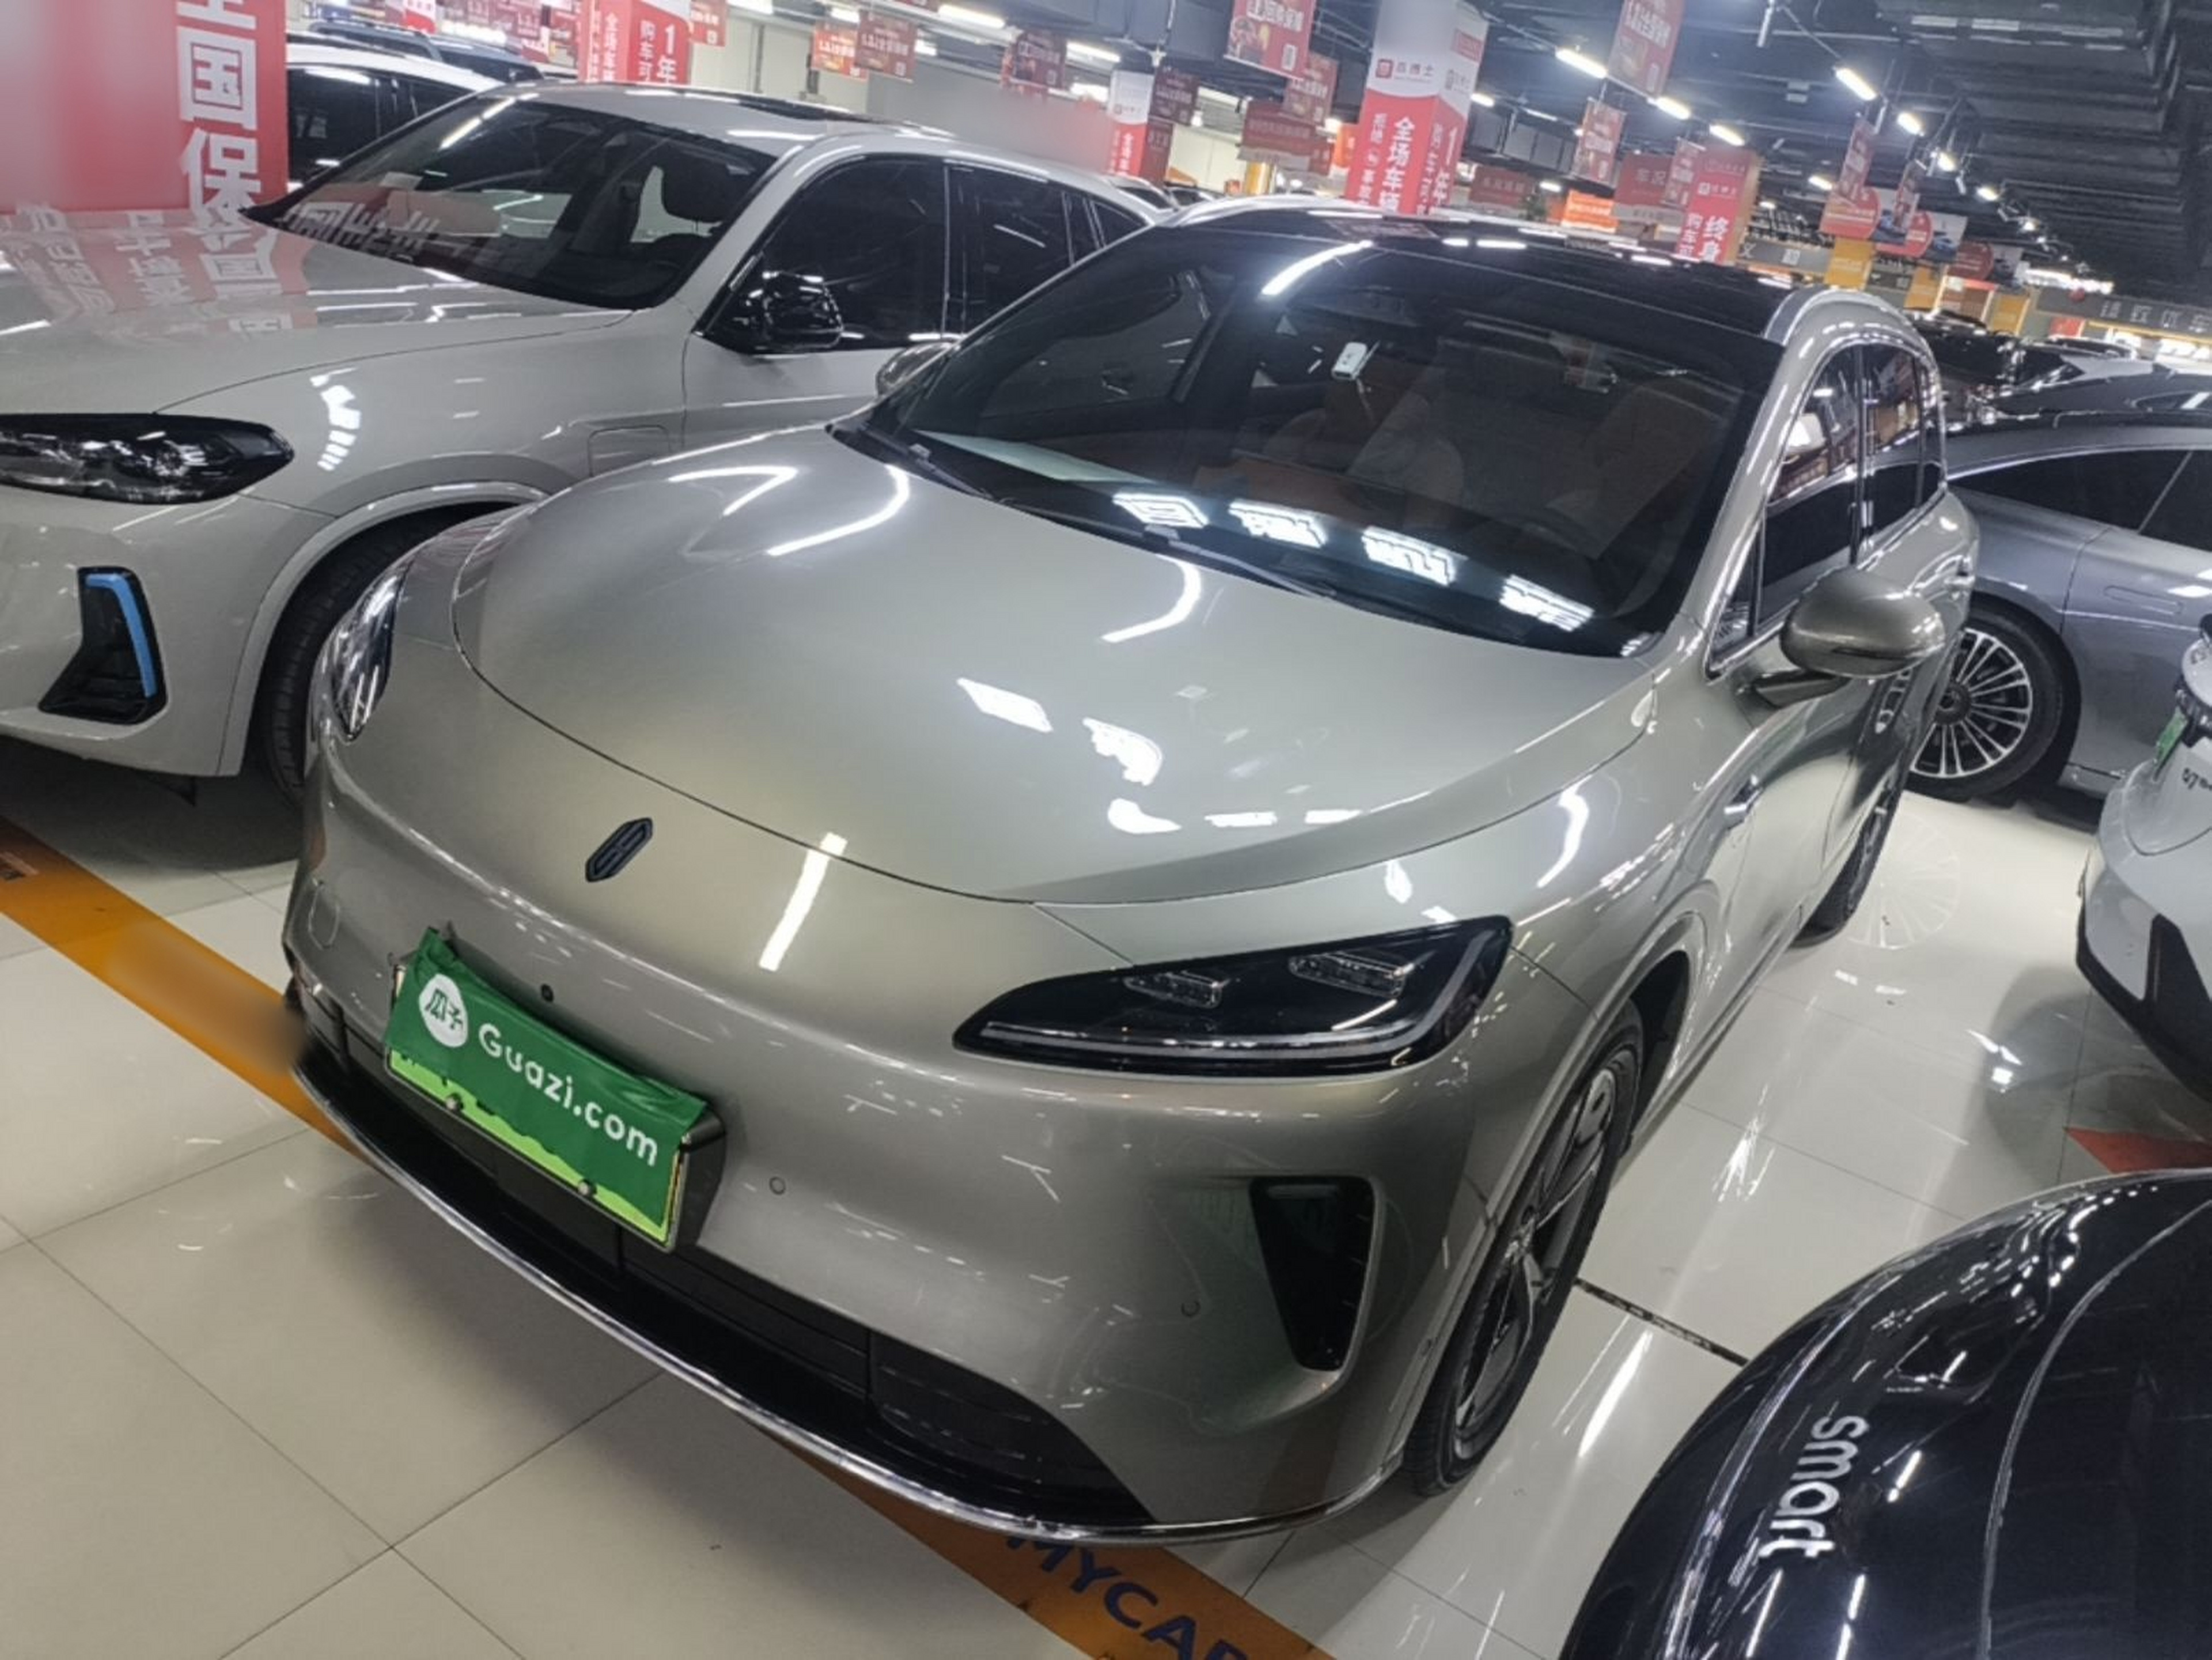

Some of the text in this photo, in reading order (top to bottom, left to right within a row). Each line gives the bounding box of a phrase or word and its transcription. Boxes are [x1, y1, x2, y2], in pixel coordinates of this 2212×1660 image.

[656, 23, 677, 83] 1年
[1698, 215, 1729, 263] 终身
[424, 989, 464, 1030] 瓜子
[478, 1023, 658, 1167] Guazi.com
[1758, 1415, 1870, 1558] smart
